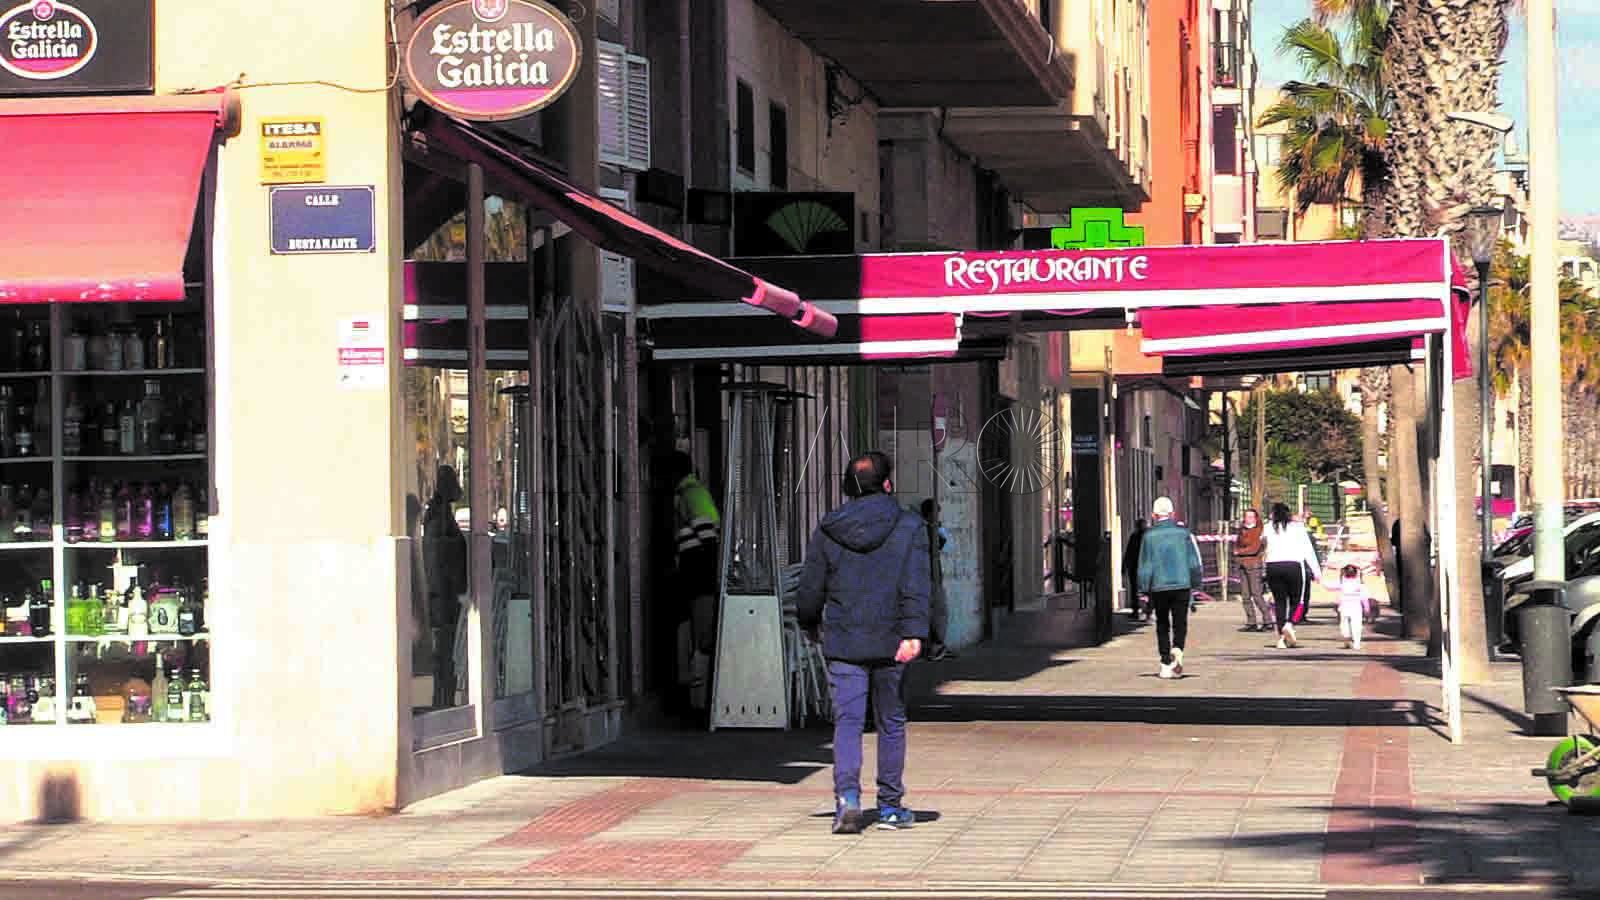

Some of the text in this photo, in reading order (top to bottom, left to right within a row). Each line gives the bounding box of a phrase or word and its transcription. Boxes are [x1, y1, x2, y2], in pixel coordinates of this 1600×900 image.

[7, 20, 82, 39] Estrella
[429, 23, 555, 54] Estrella
[11, 39, 78, 59] Galicia
[436, 54, 549, 88] Galicia
[264, 123, 318, 136] ITESA
[305, 194, 339, 206] CALLE
[944, 255, 1148, 293] RESTAURANTE
